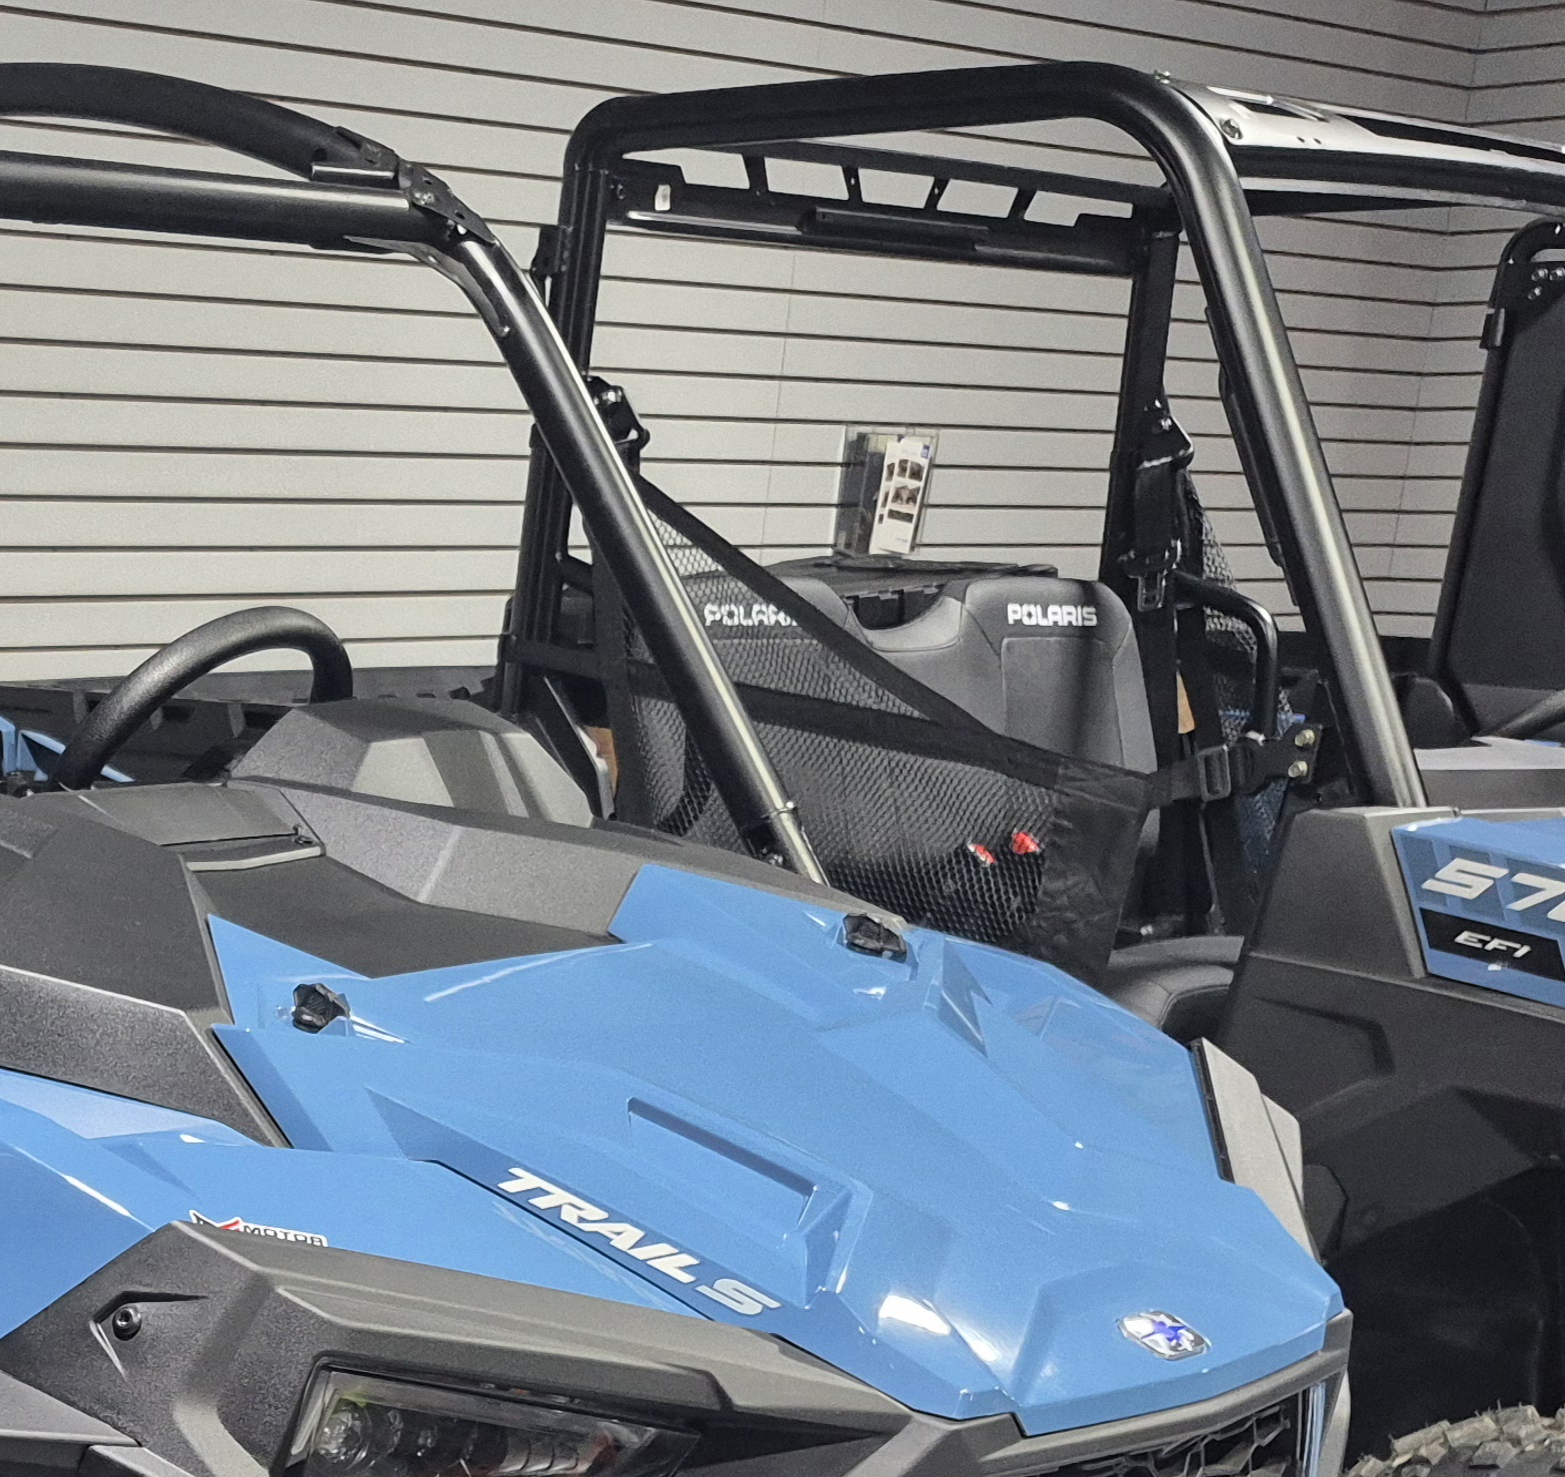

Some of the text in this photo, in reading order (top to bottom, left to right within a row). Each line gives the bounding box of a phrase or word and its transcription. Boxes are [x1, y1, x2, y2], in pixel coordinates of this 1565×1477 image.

[704, 602, 799, 627] POLAR
[1007, 603, 1097, 627] POLARIS
[1421, 857, 1565, 923] 57
[1454, 930, 1532, 958] EFI
[497, 1167, 782, 1316] TRAIL S
